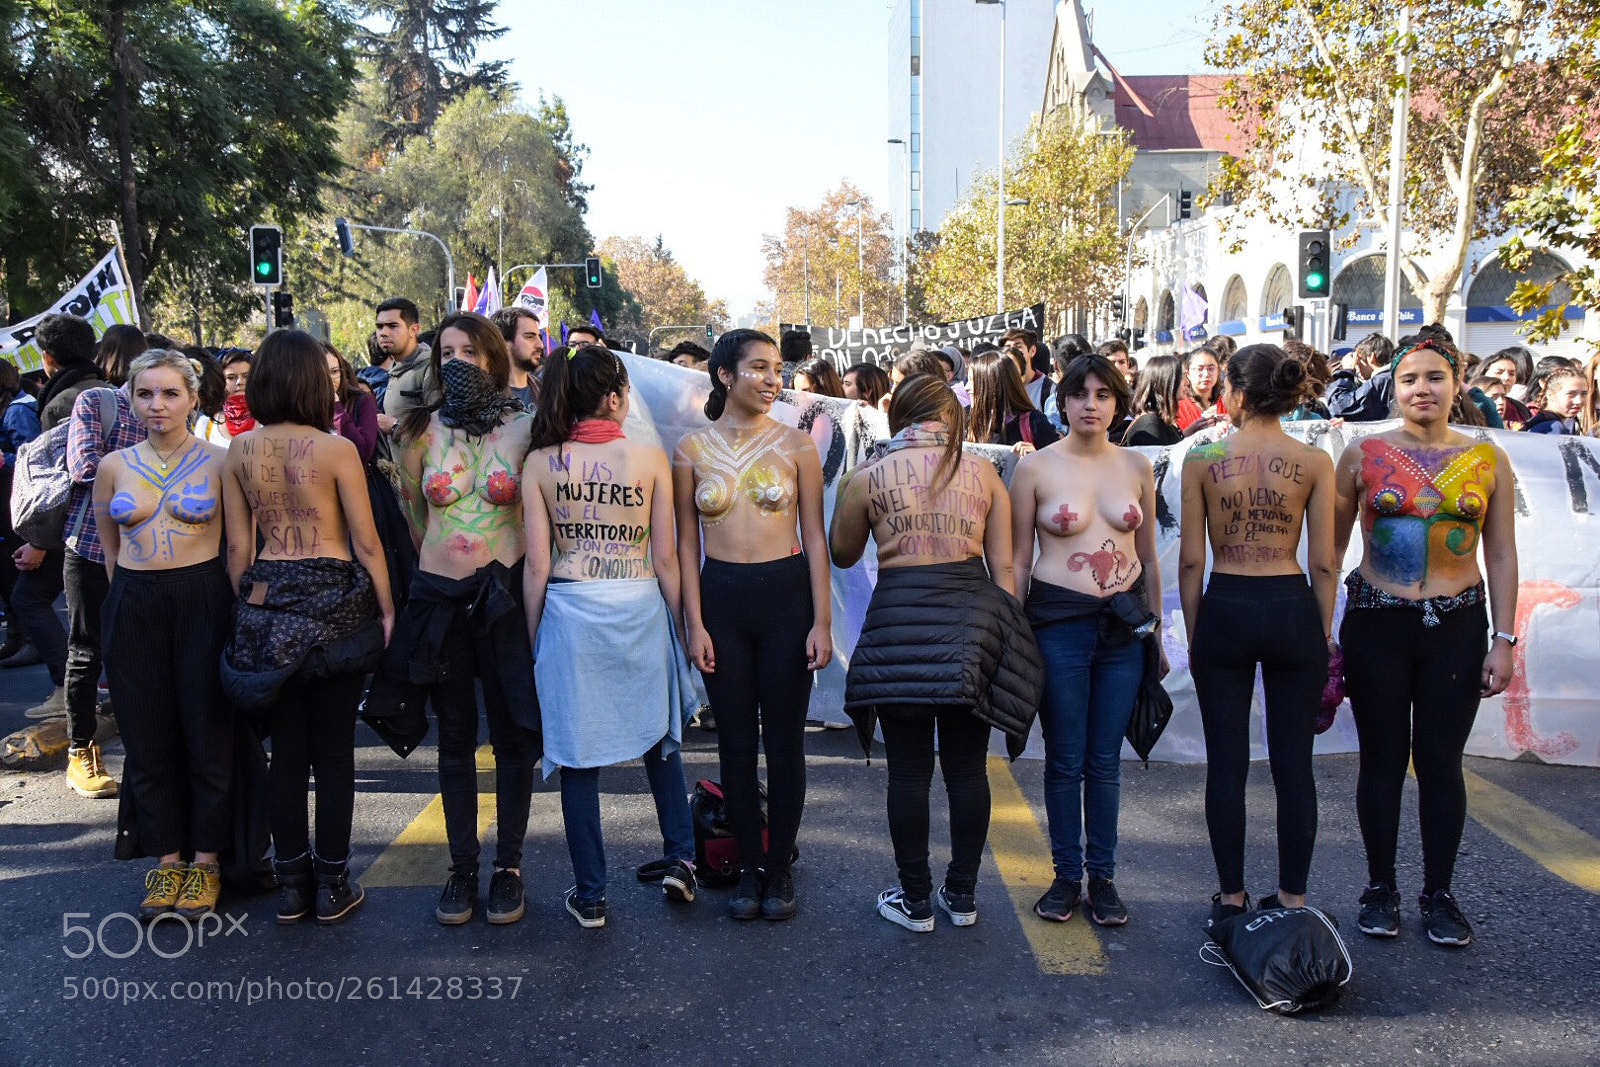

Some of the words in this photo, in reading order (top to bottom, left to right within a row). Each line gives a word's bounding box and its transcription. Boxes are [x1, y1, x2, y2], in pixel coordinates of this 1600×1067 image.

[1347, 311, 1376, 321] Banco
[242, 439, 256, 456] NI
[242, 461, 253, 481] NI
[261, 464, 280, 482] DE
[548, 452, 571, 472] NI
[582, 460, 614, 483] LAS
[868, 465, 886, 494] NI
[893, 459, 920, 485] LA
[1269, 457, 1305, 485] QUE
[556, 482, 644, 507] MUJERES
[871, 490, 889, 516] NI
[889, 487, 911, 512] EL
[1221, 491, 1243, 511] NO
[1248, 487, 1288, 509] VENDE
[555, 505, 571, 521] NI
[583, 504, 601, 520] EL
[1232, 511, 1246, 523] AL
[1248, 509, 1293, 523] MERCADO
[887, 515, 912, 535] SON
[915, 512, 956, 535] OBJETO
[960, 518, 976, 538] DE
[1224, 524, 1239, 535] LO
[1245, 532, 1260, 541] EL
